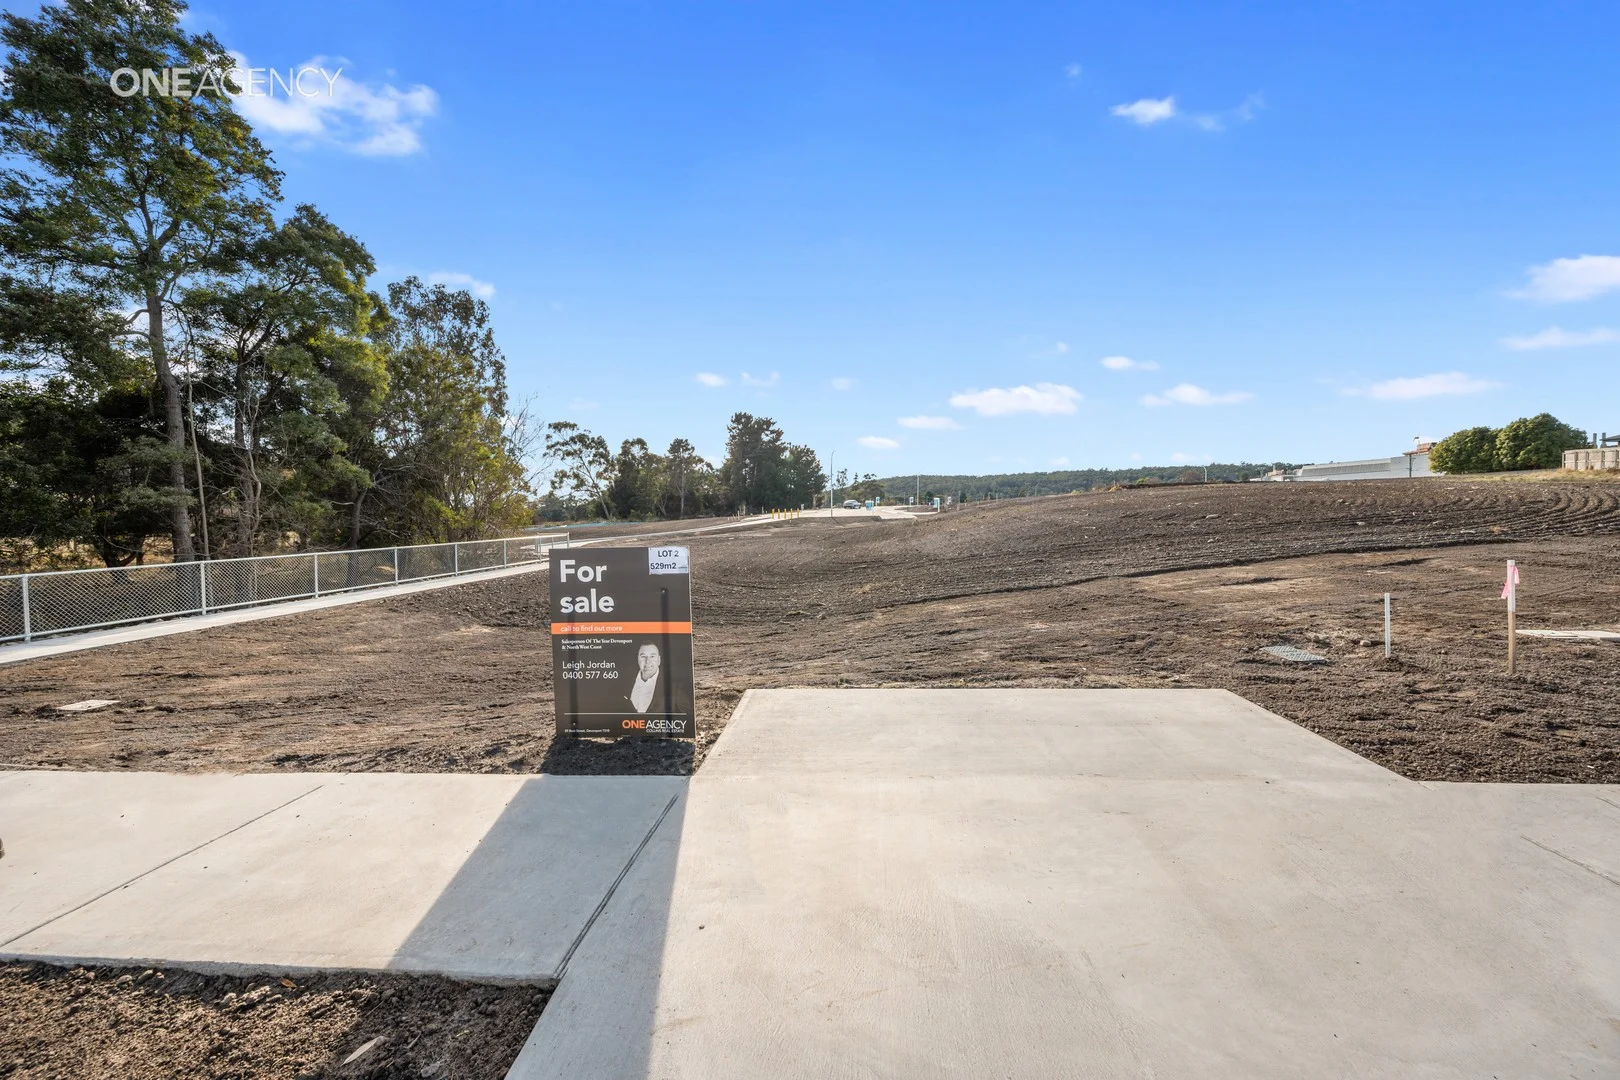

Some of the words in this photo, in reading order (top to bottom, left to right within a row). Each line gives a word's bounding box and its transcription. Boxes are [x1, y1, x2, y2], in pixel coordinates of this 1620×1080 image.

[657, 550, 673, 558] LOT
[674, 550, 680, 558] 2
[650, 562, 677, 570] 529m2
[559, 559, 607, 583] For
[560, 588, 615, 614] sale
[560, 624, 572, 632] call
[580, 624, 594, 632] find
[562, 661, 585, 671] Leigh
[586, 660, 616, 669] Jordan
[562, 671, 584, 679] 0400
[585, 671, 601, 679] 577
[602, 671, 619, 679] 660
[622, 719, 687, 729] ONEAGENCY
